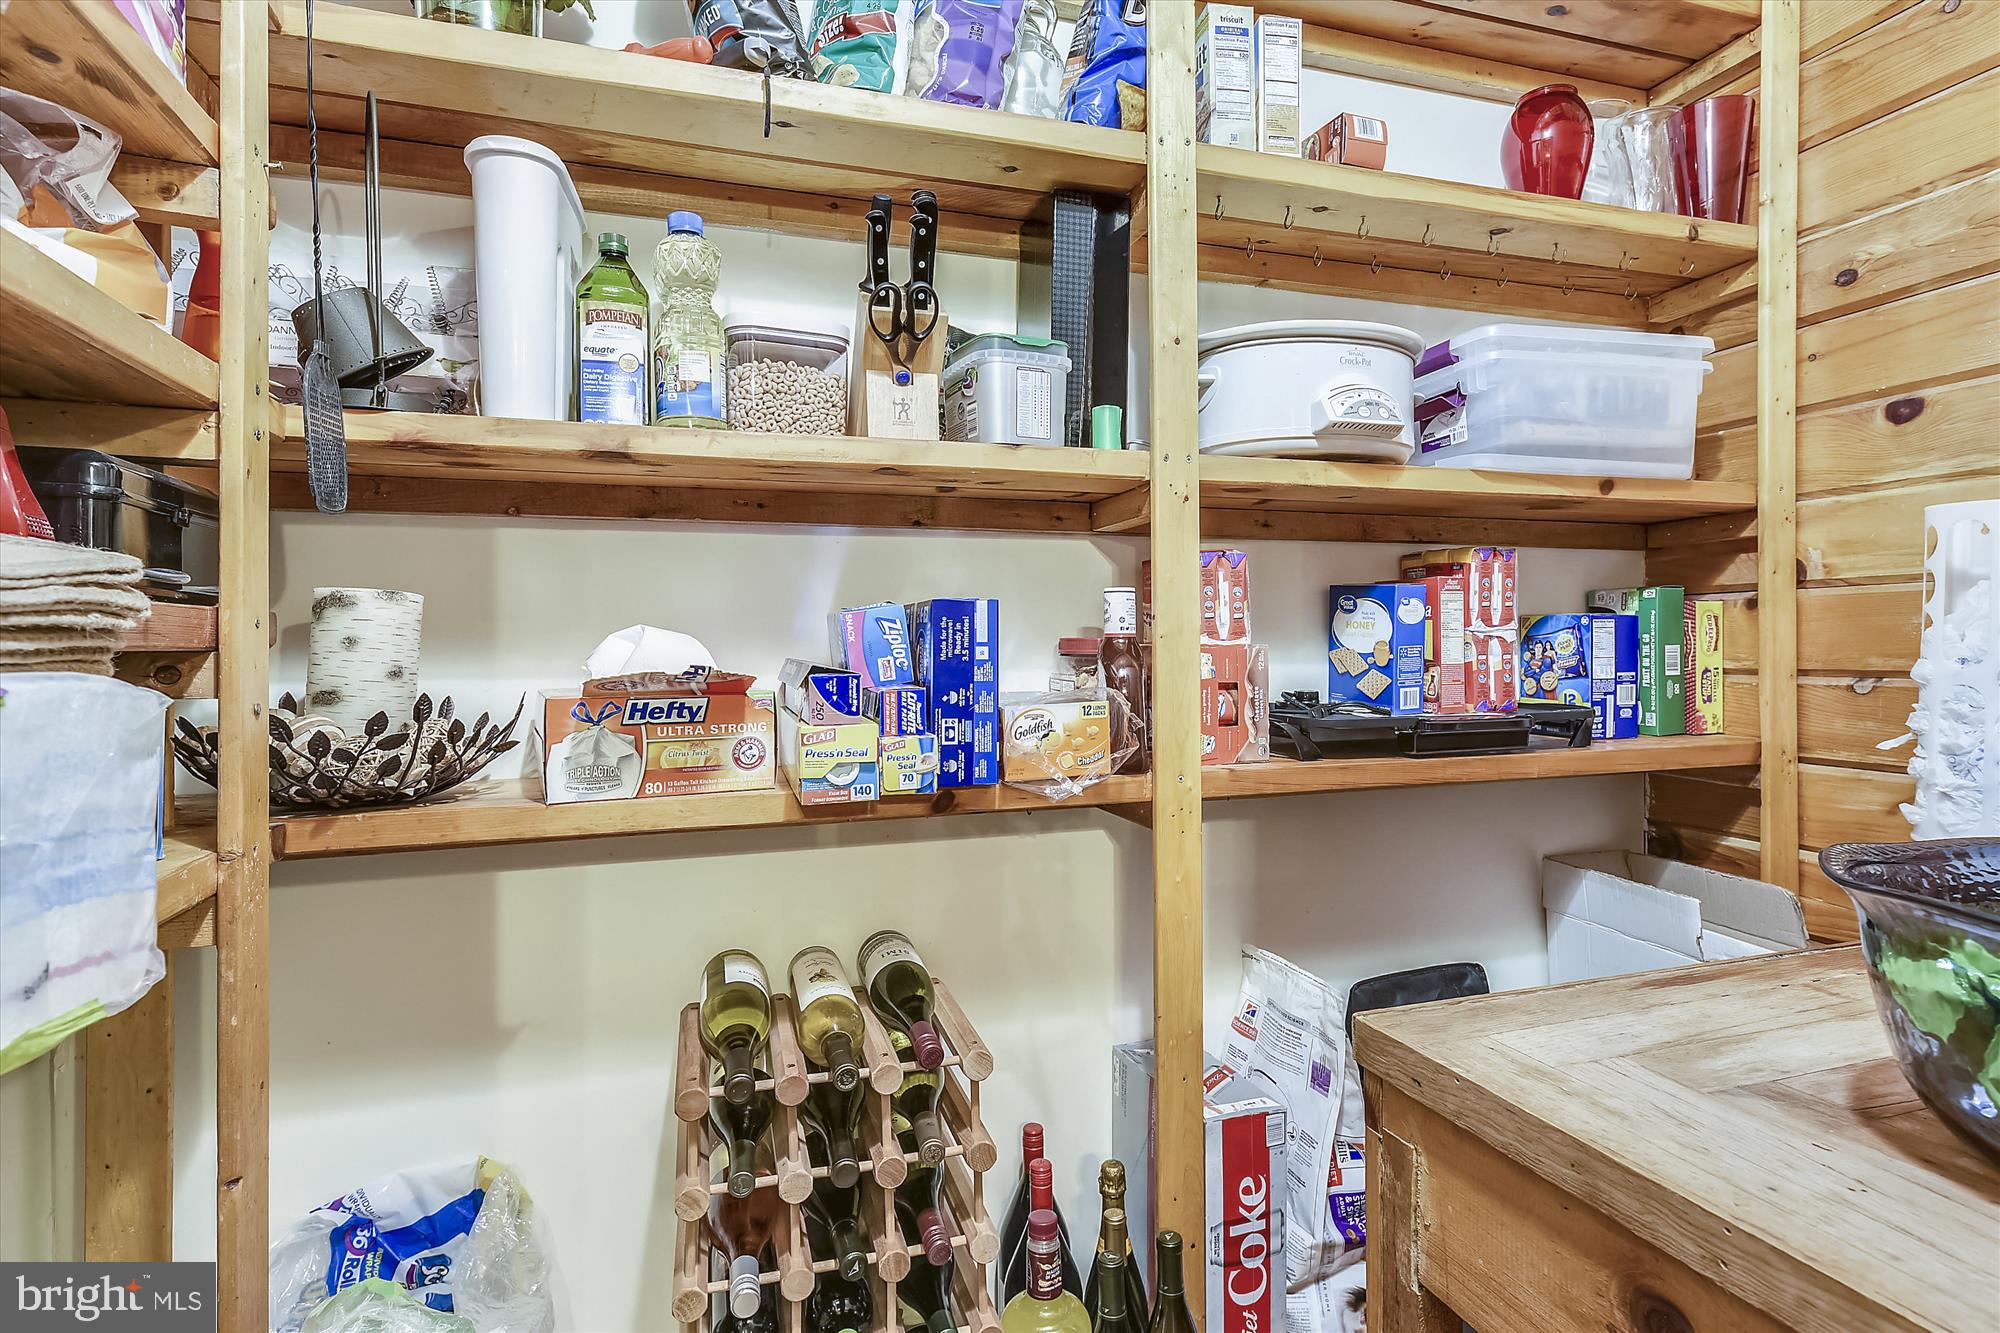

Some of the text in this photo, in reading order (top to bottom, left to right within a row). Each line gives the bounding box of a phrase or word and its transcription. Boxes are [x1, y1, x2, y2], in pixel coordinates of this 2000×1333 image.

[1220, 15, 1244, 24] triscuit
[588, 310, 639, 326] POMPEIAN
[583, 345, 616, 355] equate
[583, 373, 603, 381] Dairy
[845, 613, 856, 643] SNACK
[961, 616, 970, 648] minutes!
[1345, 620, 1376, 631] HONEY
[879, 617, 908, 669] Ziploc
[954, 633, 963, 655] Ready
[961, 649, 970, 661] 3.5
[1642, 668, 1651, 687] FRUIT
[1712, 666, 1720, 678] 15
[1564, 693, 1577, 704] 12
[627, 701, 704, 722] Hefty
[815, 700, 825, 721] 250
[1082, 704, 1092, 716] 12
[657, 721, 768, 737] ULTRA STRONG
[1014, 718, 1053, 741] Goldfish
[802, 730, 835, 745] GLAD
[668, 749, 710, 758] Citrus Twist
[804, 747, 869, 759] Press'n Seal
[884, 741, 905, 752] GLAD
[886, 753, 918, 762] Press'n
[1076, 749, 1106, 767] Cheddar
[566, 765, 621, 779] TRIPLE ACTION
[897, 761, 916, 770] Seal
[901, 773, 914, 783] 70
[644, 781, 663, 795] 80
[852, 785, 873, 797] 140
[1336, 1140, 1348, 1164] Hill's
[1338, 1196, 1346, 1217] ADULT
[352, 1226, 372, 1250] 36
[1227, 1174, 1267, 1306] Coke
[1241, 1308, 1258, 1333] iet
